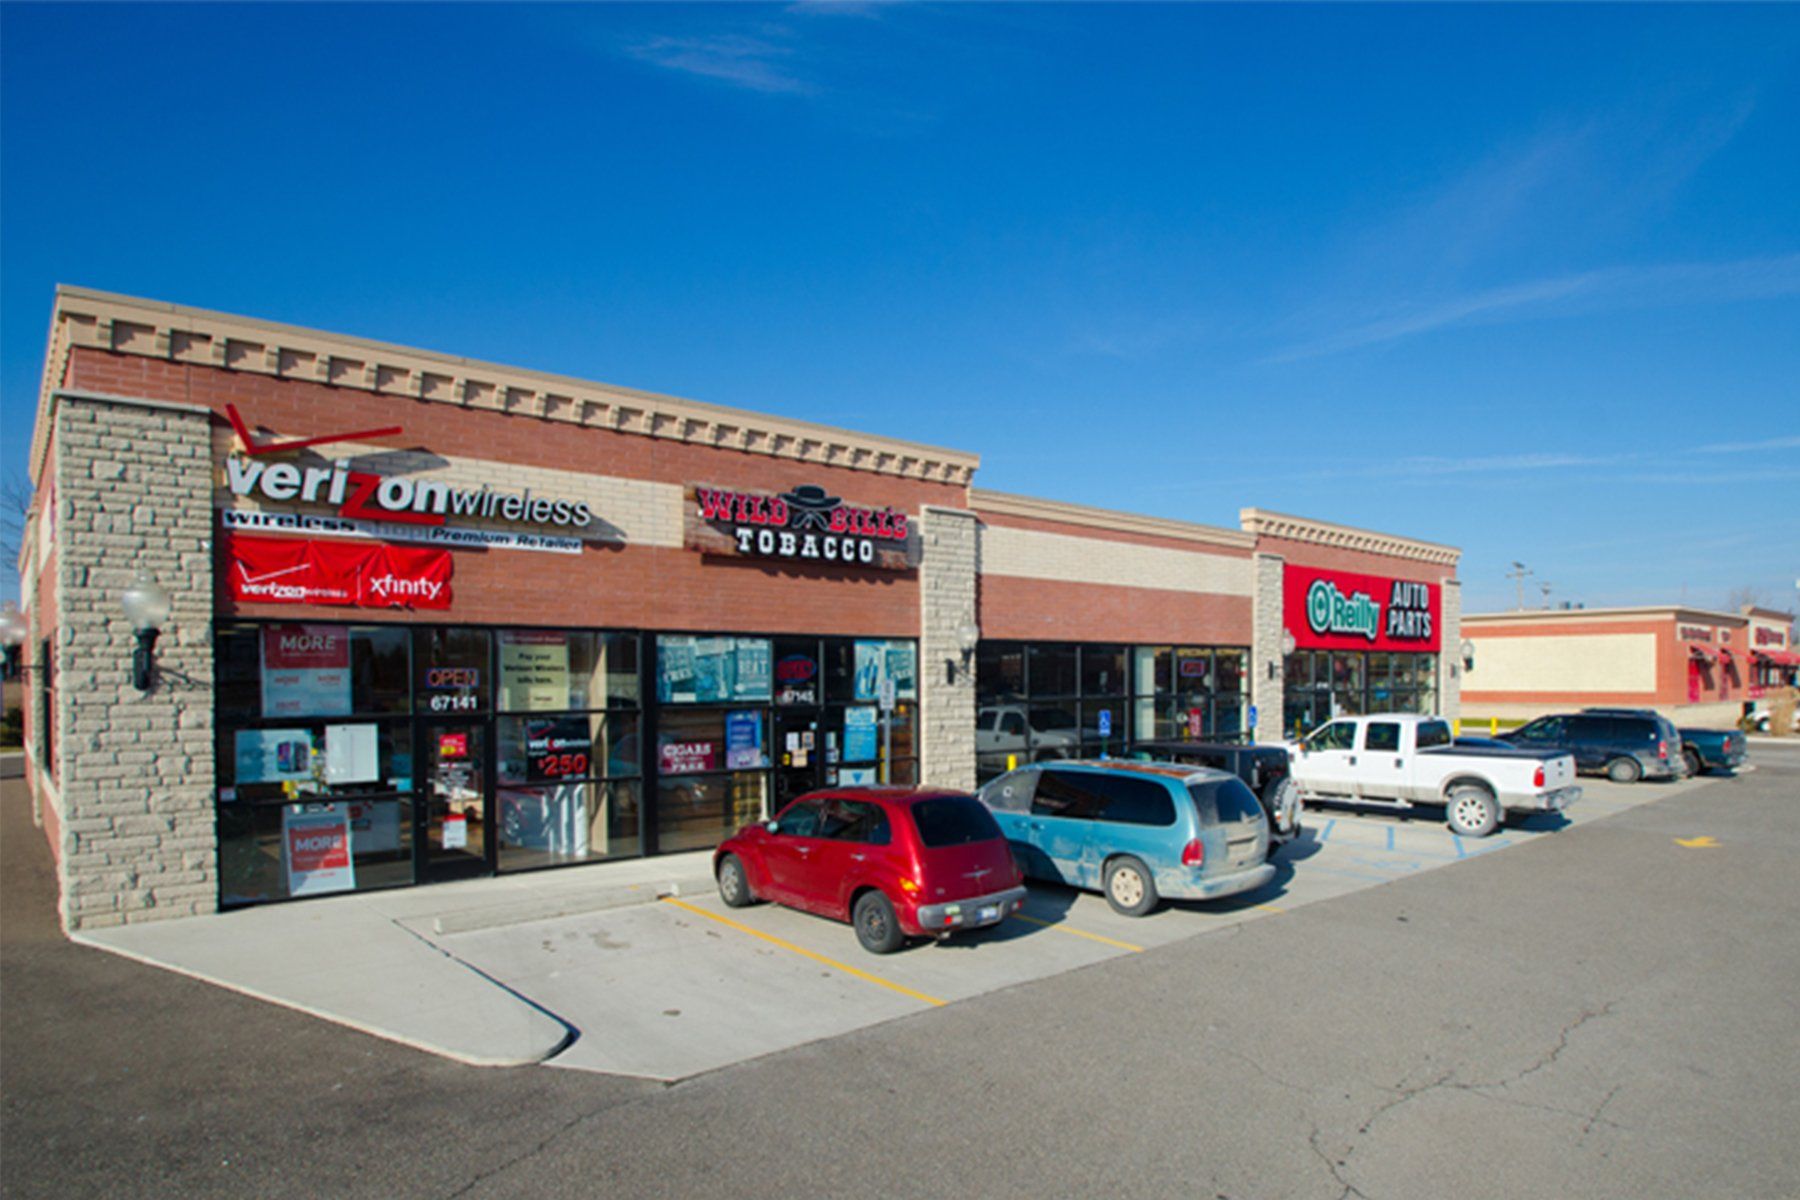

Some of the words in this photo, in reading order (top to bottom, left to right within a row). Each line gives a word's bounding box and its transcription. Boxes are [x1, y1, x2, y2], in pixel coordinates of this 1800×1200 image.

[700, 488, 788, 525] WILD
[225, 511, 356, 532] wireless
[432, 526, 510, 545] Premium
[516, 534, 580, 550] Retailer
[736, 528, 873, 563] TOBACCO
[370, 573, 443, 600] xfinity
[1390, 581, 1430, 609] AUTO
[1307, 579, 1380, 640] O'Reilly
[1386, 609, 1432, 638] PARTS
[281, 635, 336, 651] MORE
[428, 669, 477, 687] OPEN
[430, 695, 478, 711] 67141
[538, 754, 587, 776] $250
[295, 835, 343, 852] MORE
